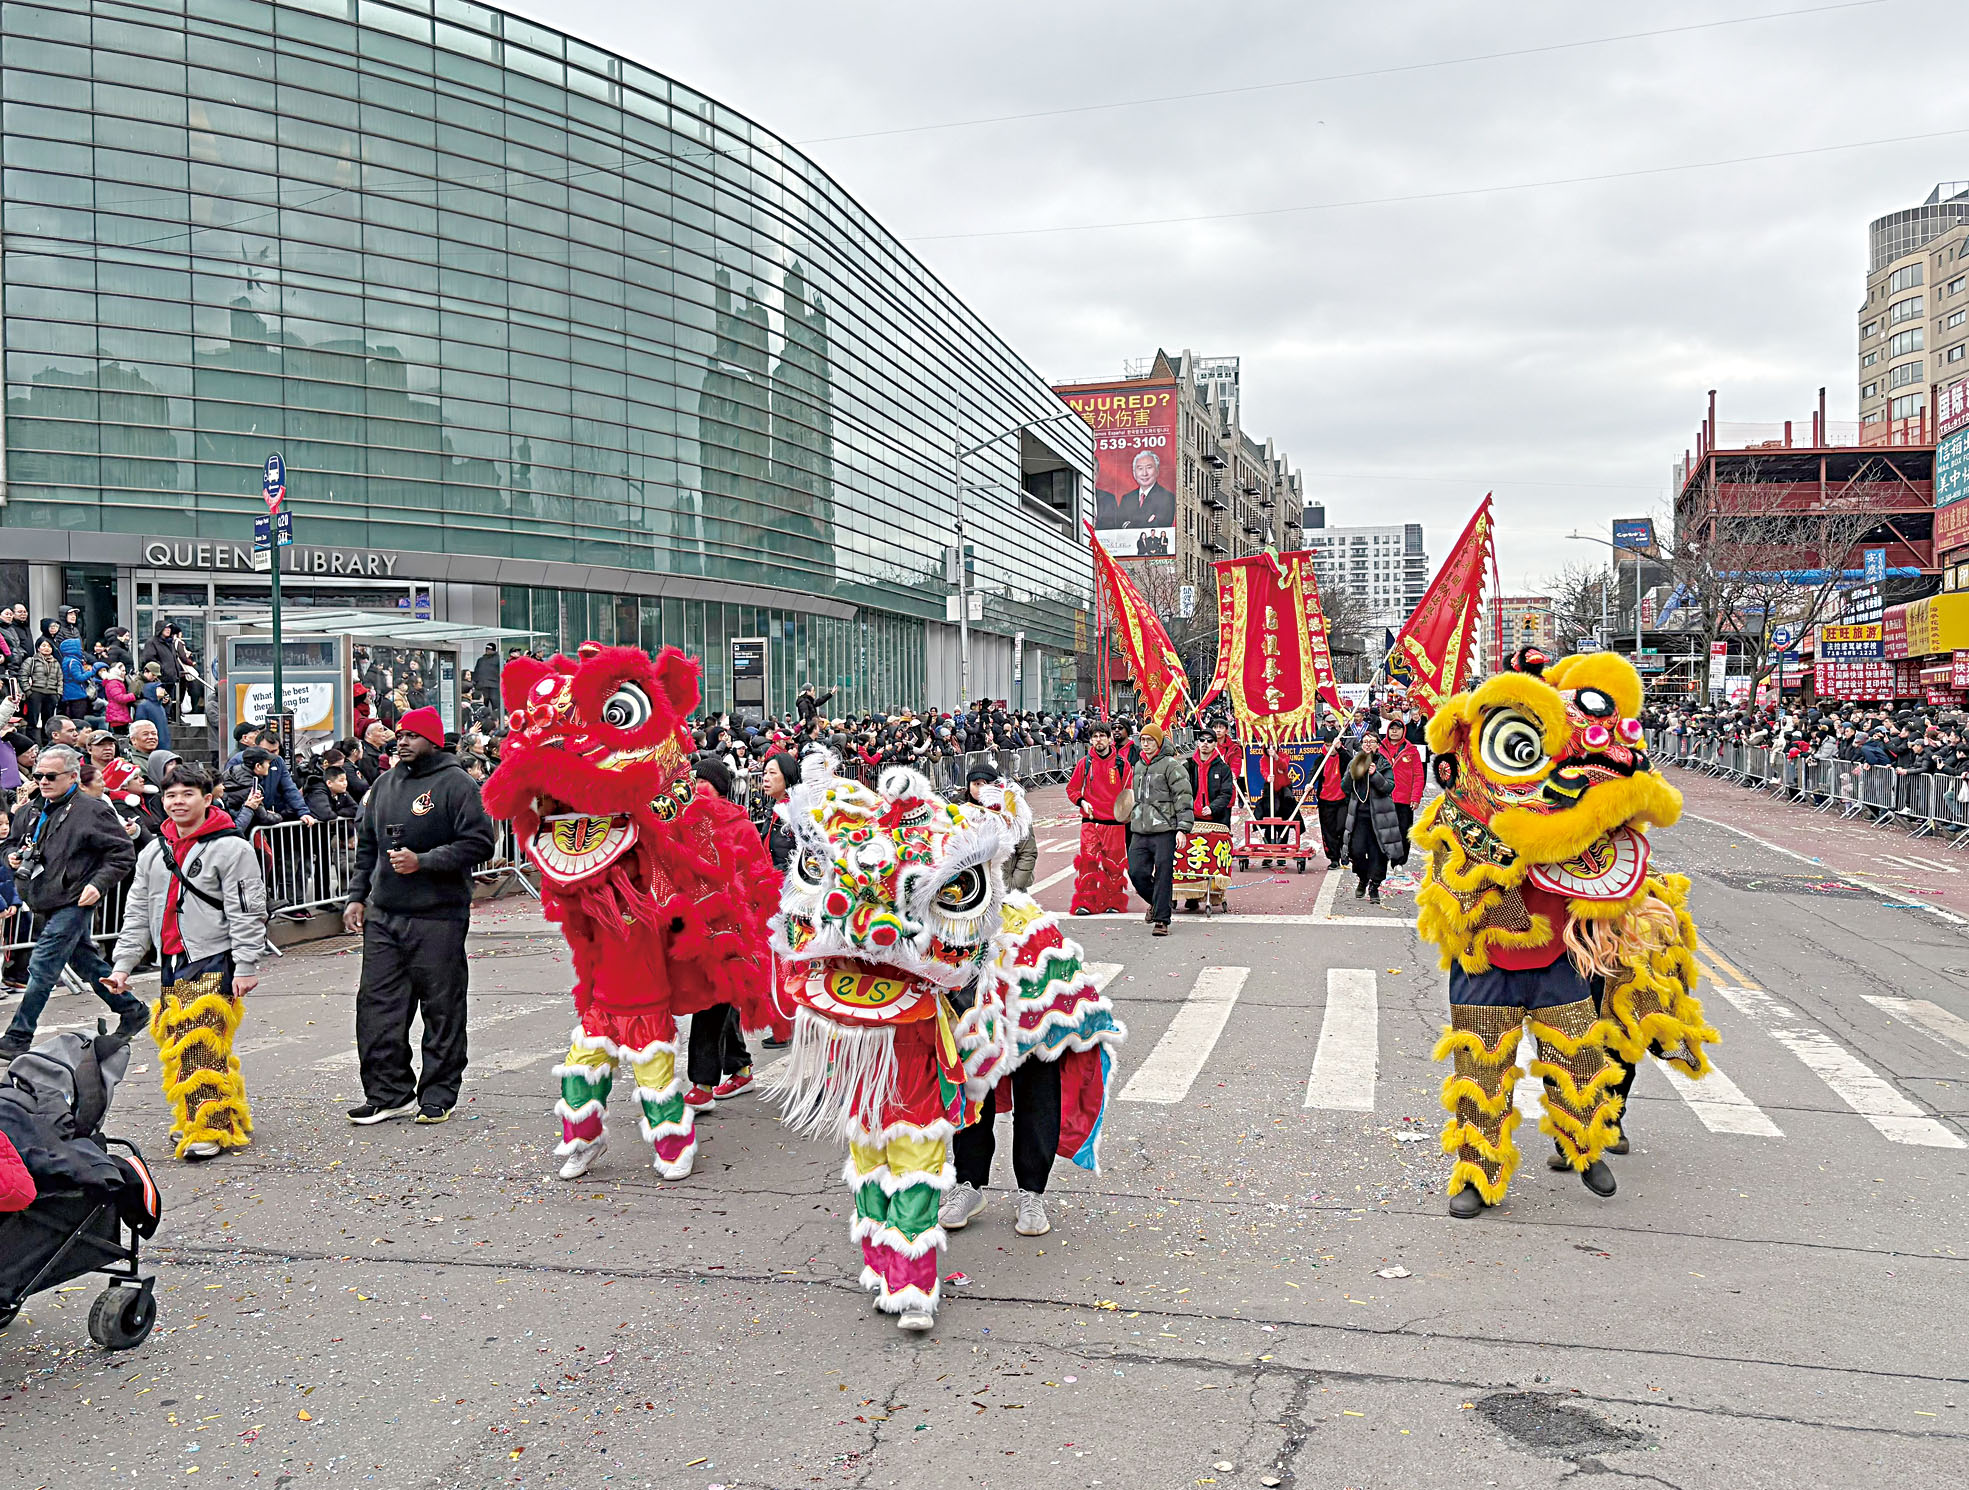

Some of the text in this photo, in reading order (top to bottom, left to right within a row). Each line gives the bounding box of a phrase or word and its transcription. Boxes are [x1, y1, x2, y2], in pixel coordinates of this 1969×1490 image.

[1069, 394, 1171, 412] NJURED?
[1081, 409, 1150, 429] 意外伤害
[1100, 436, 1167, 450] 539-3100
[277, 514, 289, 528] Q20
[145, 541, 397, 576] QUEEN LIBRARY
[1826, 626, 1877, 640] 旺旺旅游
[253, 691, 274, 702] What'
[293, 686, 309, 695] best
[299, 697, 309, 705] for
[1173, 836, 1233, 875] 李佛
